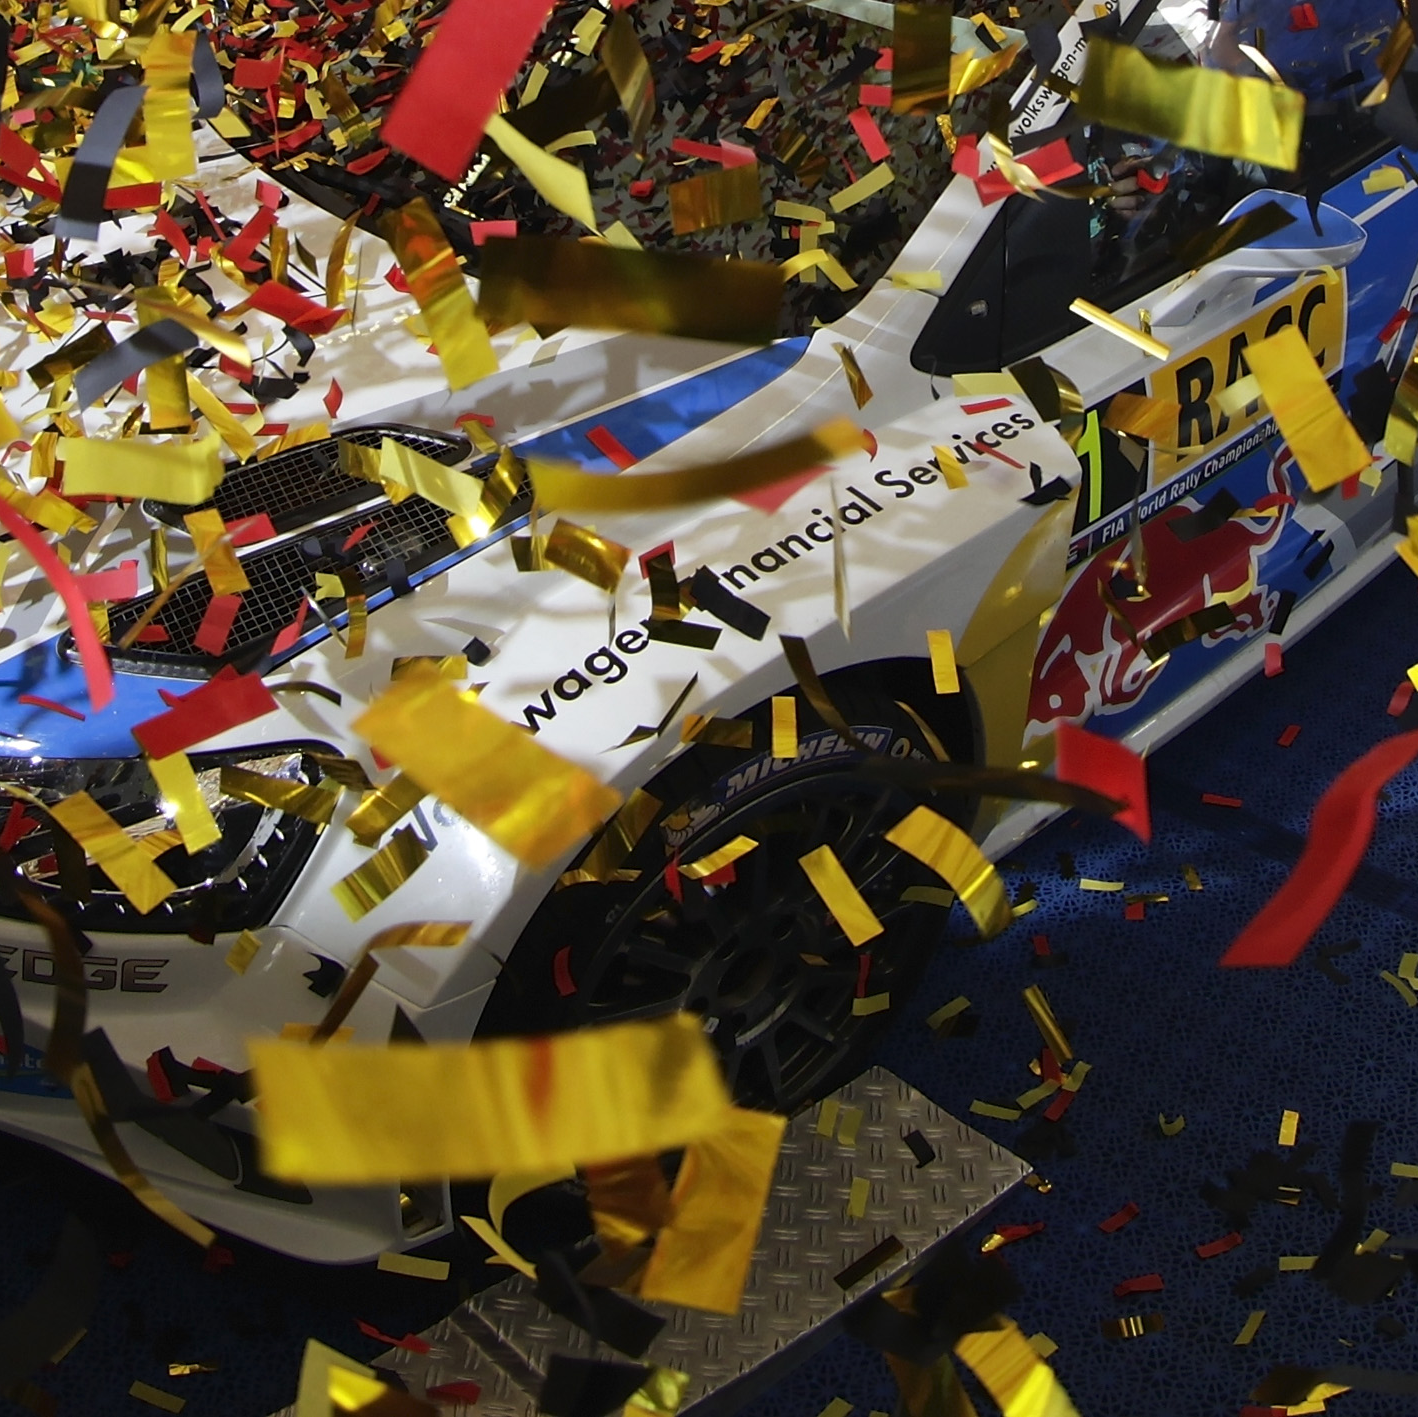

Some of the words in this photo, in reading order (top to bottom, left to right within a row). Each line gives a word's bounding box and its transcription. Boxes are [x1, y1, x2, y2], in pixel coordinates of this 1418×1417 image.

[1077, 409, 1102, 523] 1
[1101, 519, 1125, 544] FIA
[1134, 495, 1166, 520] orld
[1170, 470, 1202, 501] Rally
[721, 486, 885, 590] nancial
